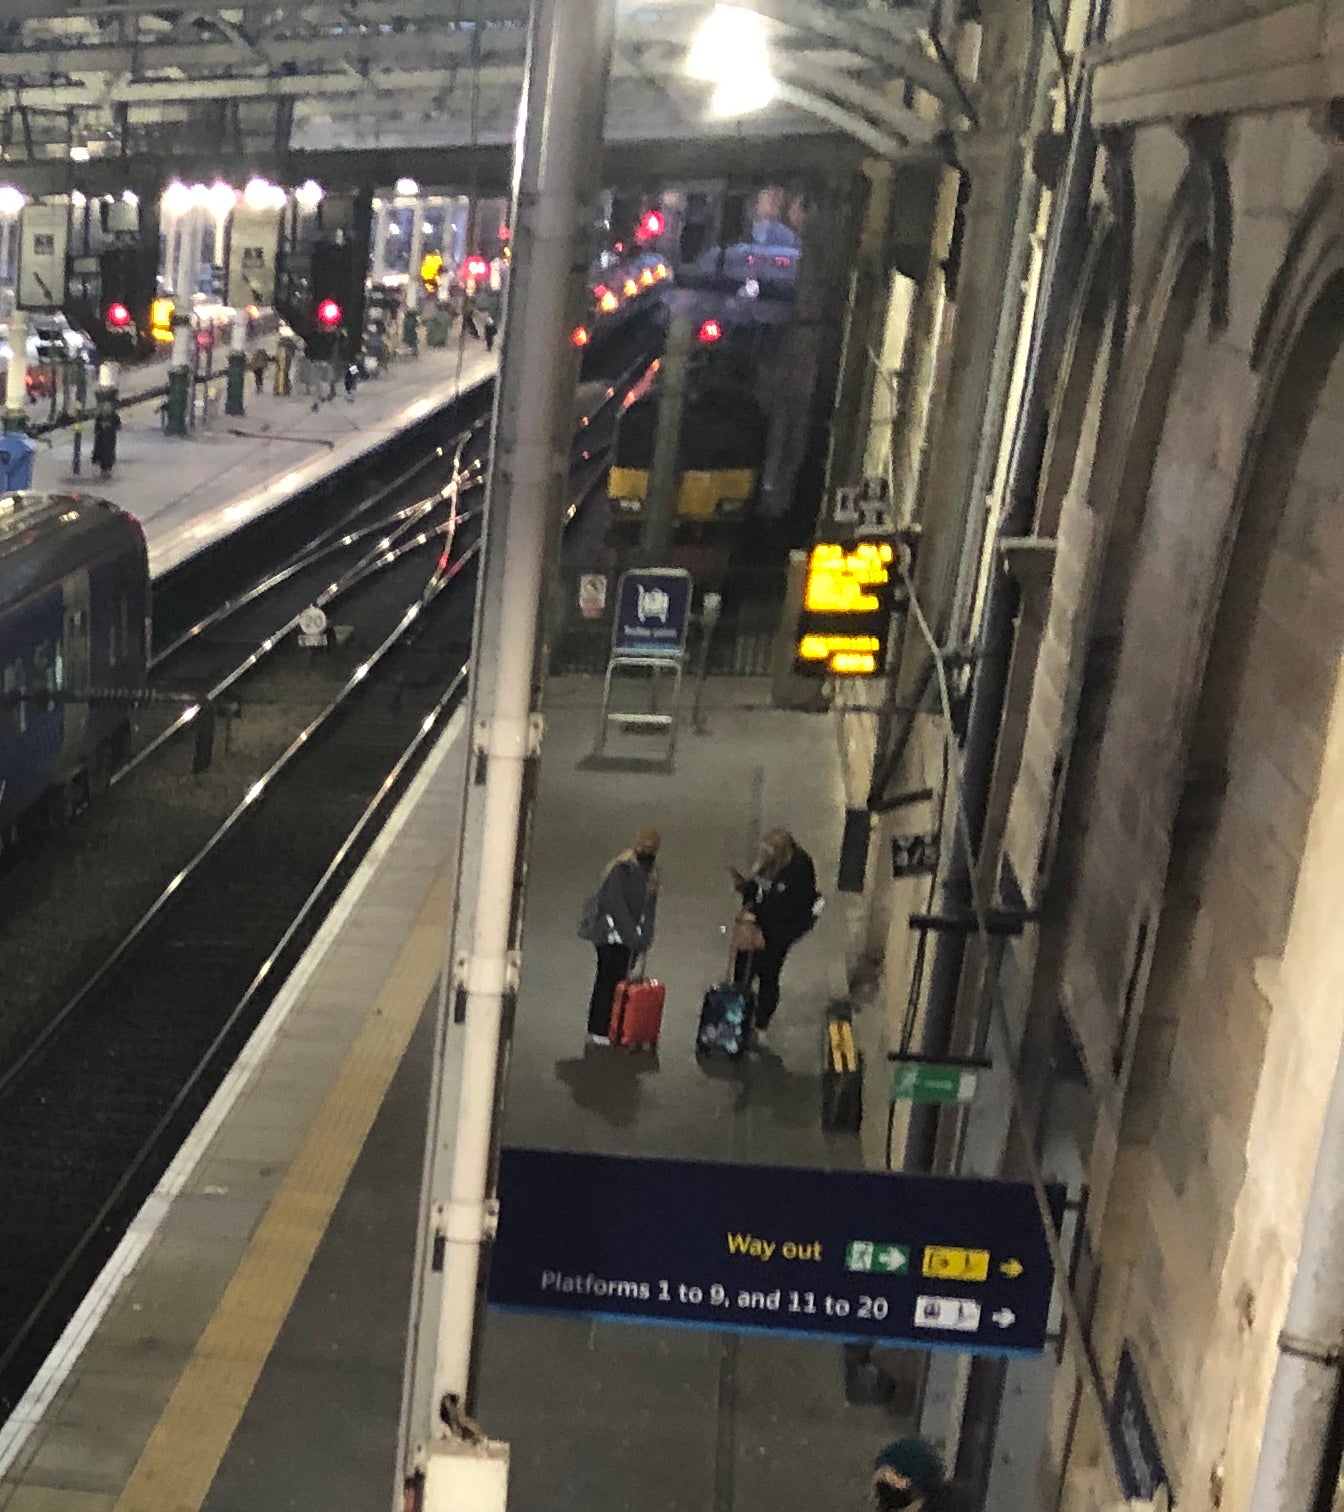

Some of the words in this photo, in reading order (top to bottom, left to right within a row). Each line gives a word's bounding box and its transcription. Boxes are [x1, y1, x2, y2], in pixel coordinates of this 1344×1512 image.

[726, 1231, 776, 1262] Way
[782, 1240, 822, 1262] out
[541, 1269, 651, 1301] Platforms
[658, 1279, 671, 1301] 1
[678, 1283, 703, 1304] to
[710, 1283, 730, 1308] 9,
[737, 1289, 781, 1311] and
[787, 1290, 816, 1315] 11
[825, 1295, 850, 1317] to
[856, 1294, 889, 1320] 20
